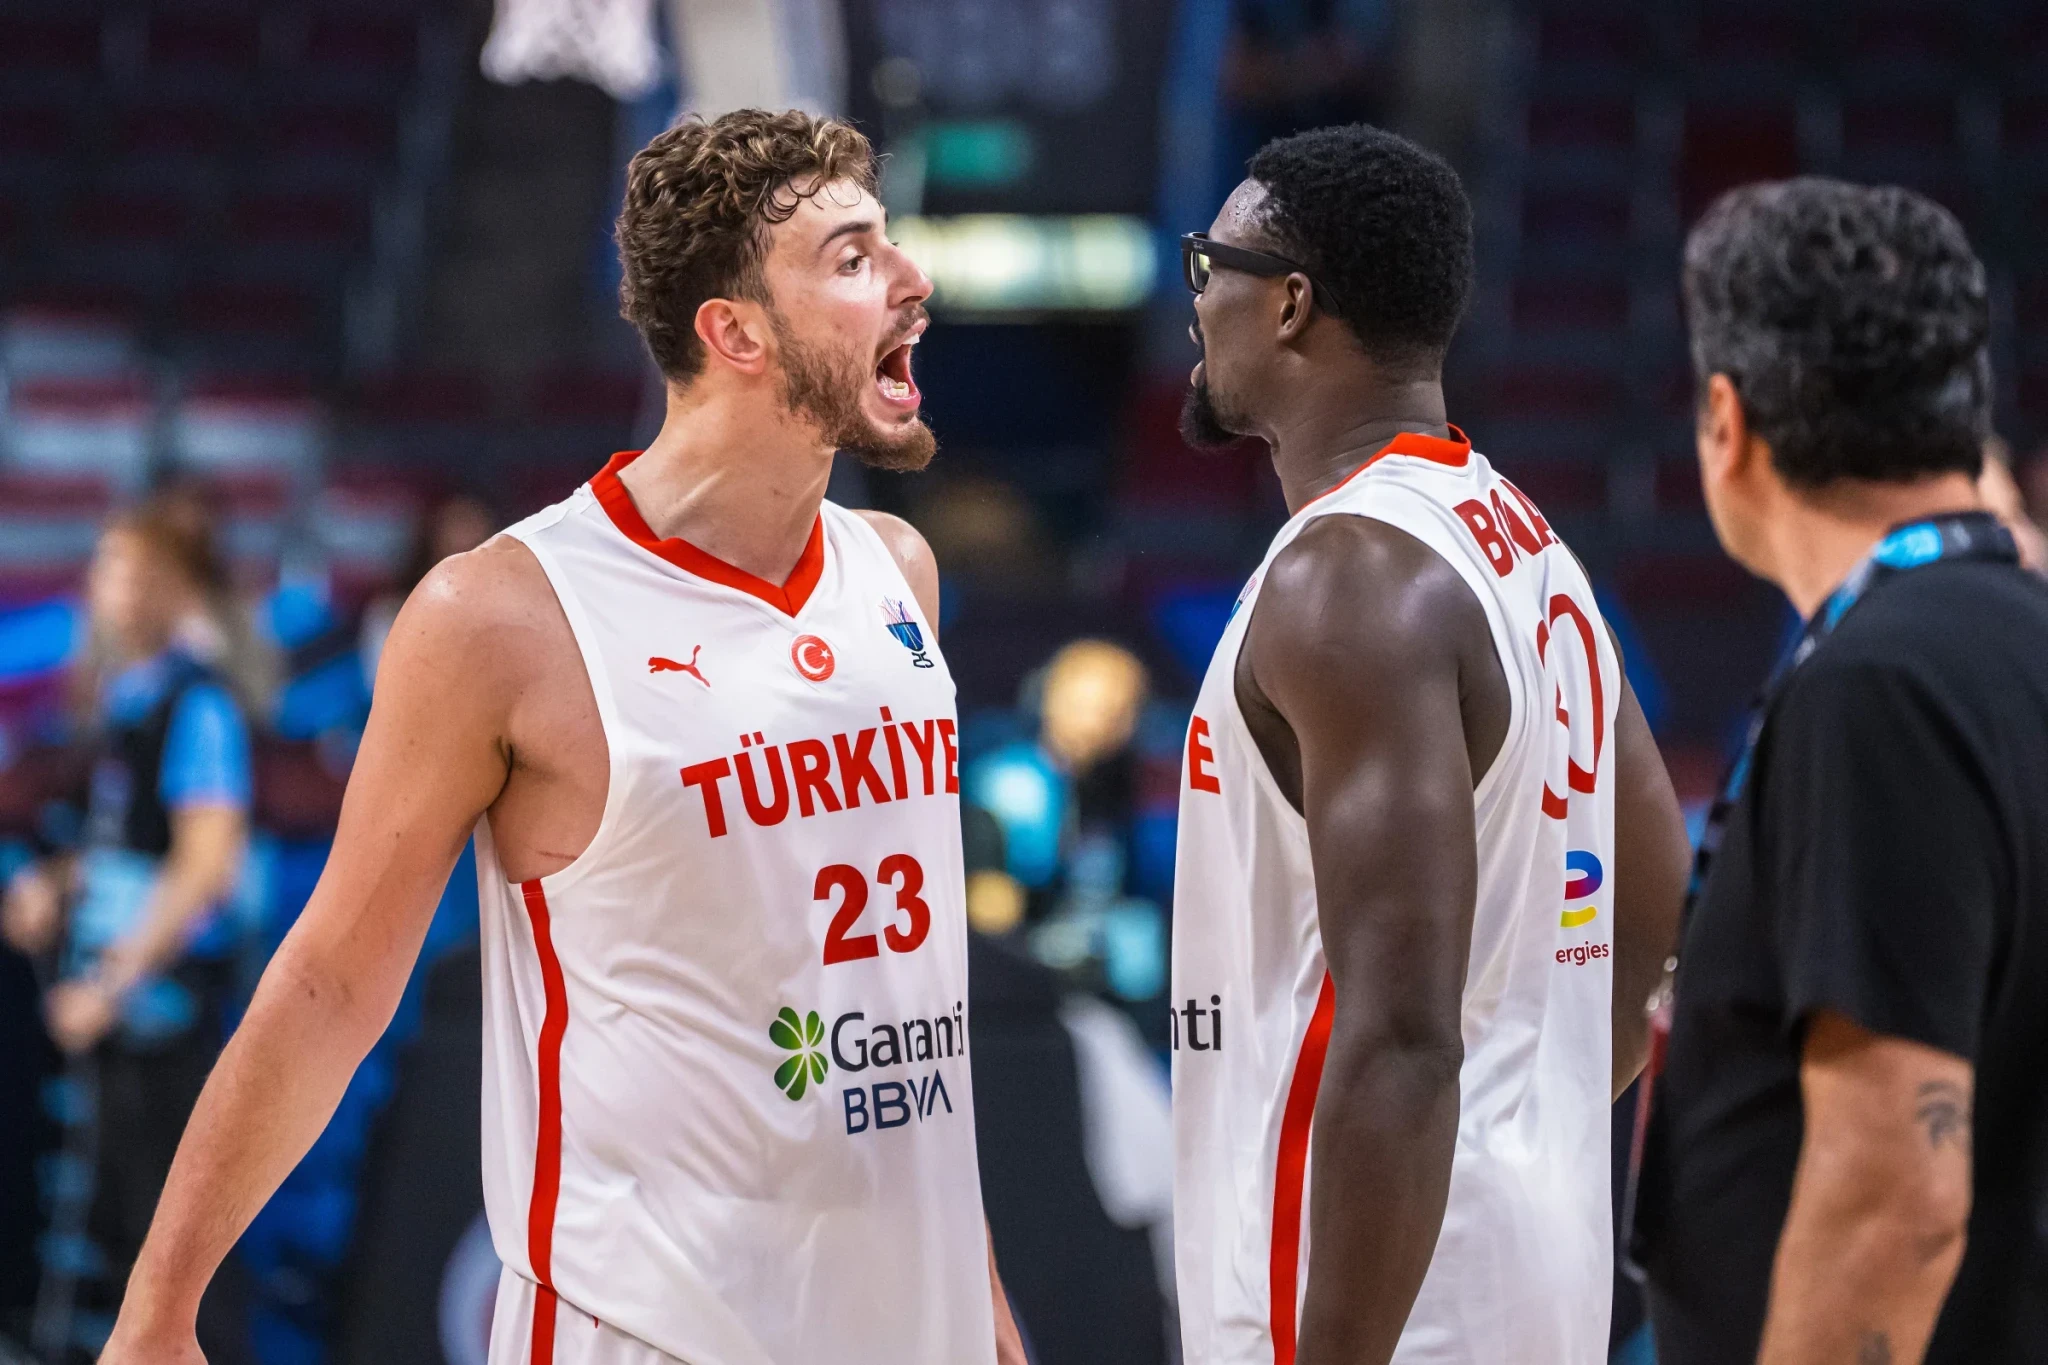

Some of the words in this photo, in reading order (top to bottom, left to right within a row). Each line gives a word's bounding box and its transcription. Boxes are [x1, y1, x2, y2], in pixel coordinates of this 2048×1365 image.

[680, 706, 959, 838] TÜRKİYE
[813, 854, 931, 966] 23
[843, 1069, 953, 1135] BBVA
